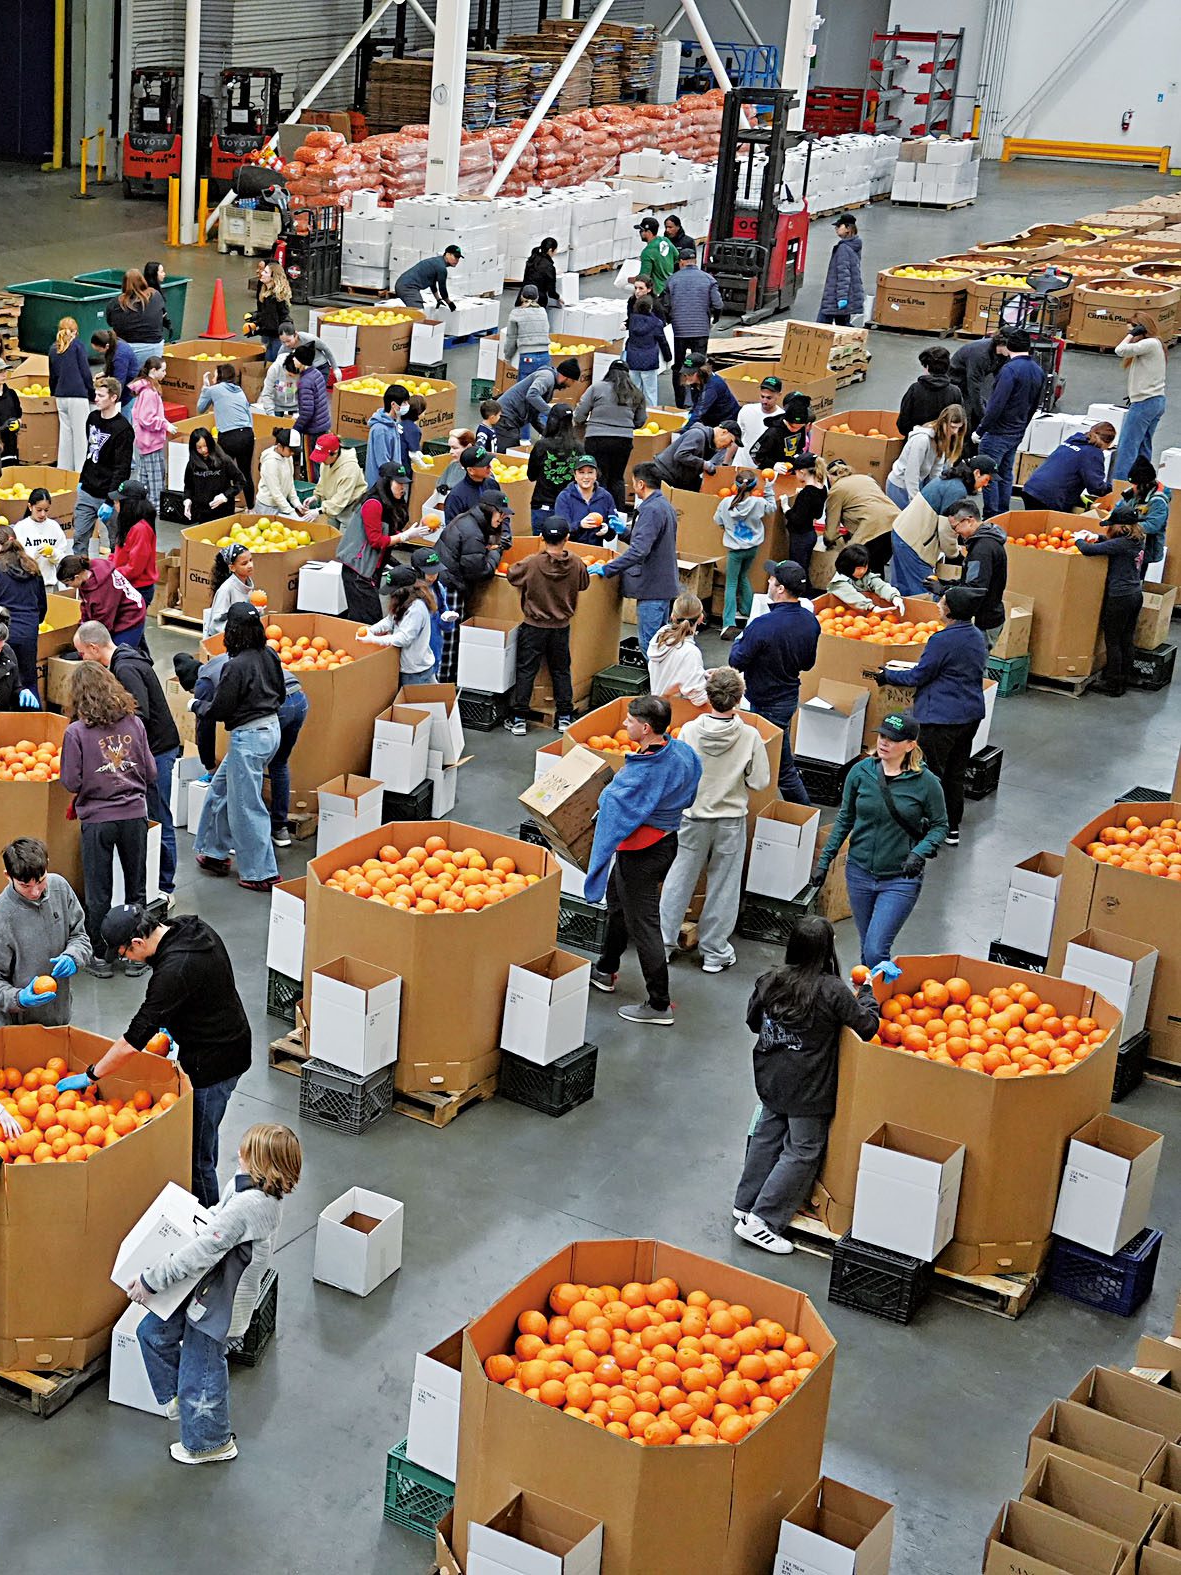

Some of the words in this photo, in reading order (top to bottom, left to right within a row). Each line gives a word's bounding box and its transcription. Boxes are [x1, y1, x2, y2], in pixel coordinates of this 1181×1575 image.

[133, 138, 168, 147] TOYOTA
[222, 140, 258, 148] TOYOTA
[341, 414, 361, 424] Citrus
[887, 689, 912, 698] SAND
[887, 695, 911, 704] POIN
[98, 734, 132, 748] STIO
